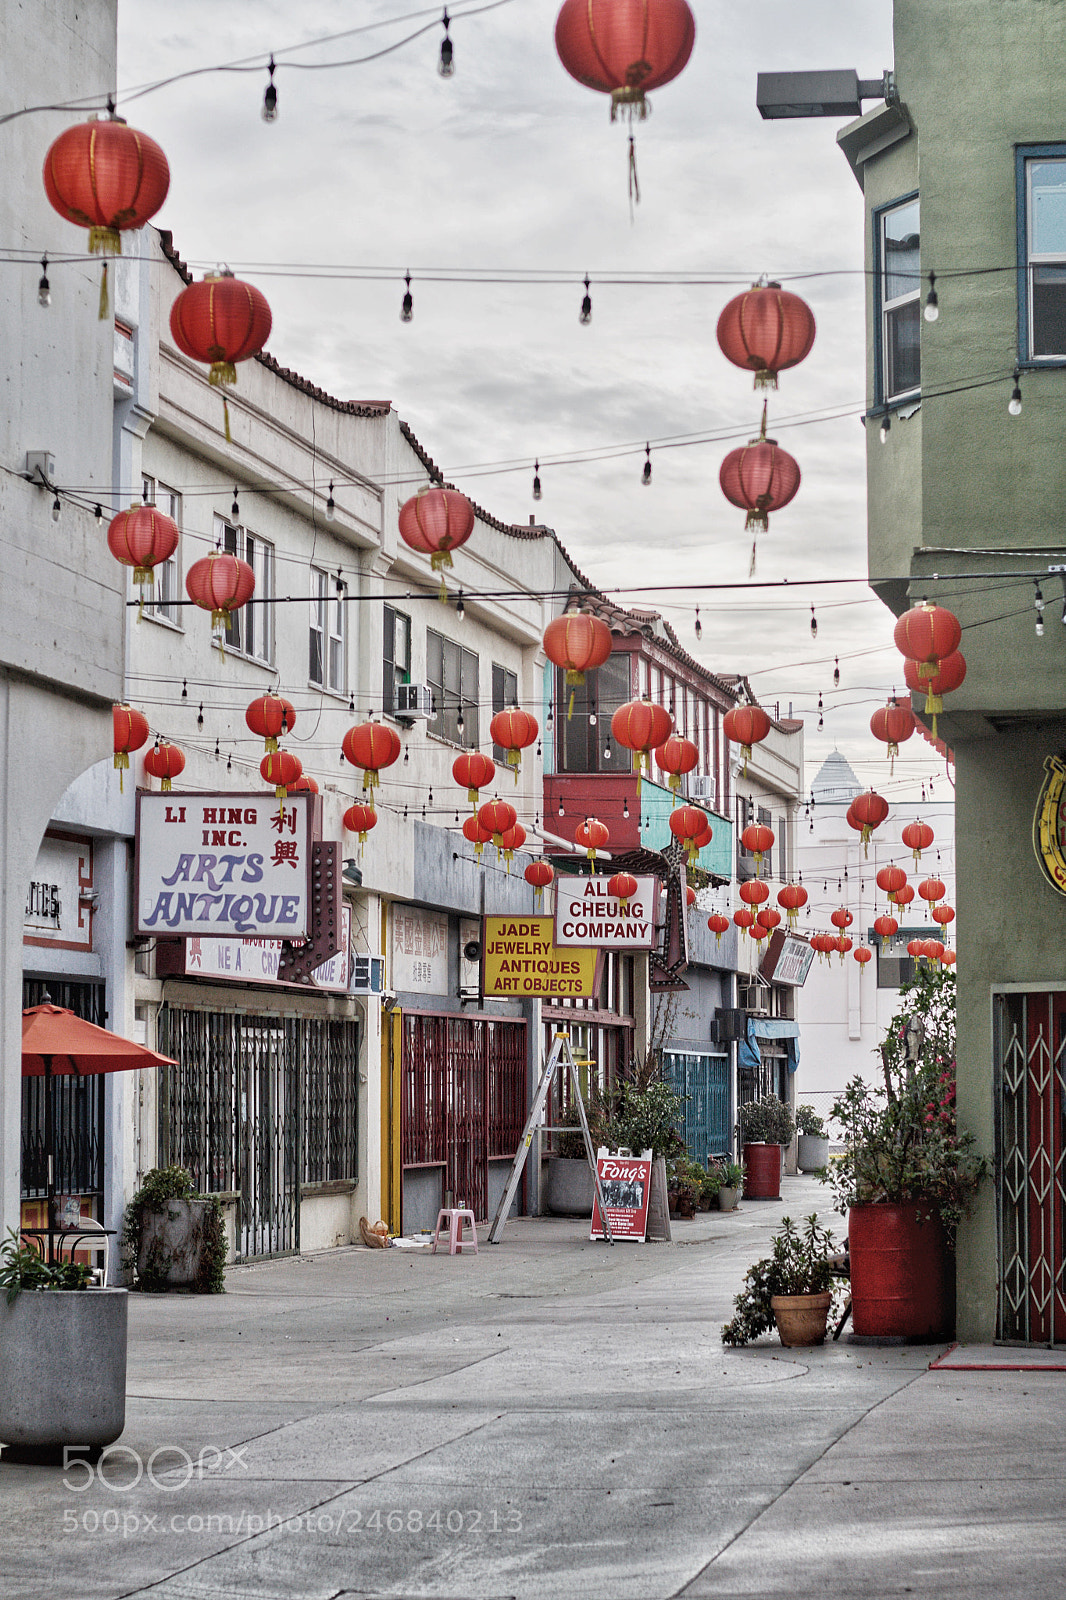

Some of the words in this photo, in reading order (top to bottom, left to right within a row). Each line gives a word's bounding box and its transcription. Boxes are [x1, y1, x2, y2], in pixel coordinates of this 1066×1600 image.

[165, 807, 186, 823] LI
[202, 808, 257, 824] HING
[202, 830, 247, 847] INC.
[270, 807, 299, 869] 利興
[161, 853, 264, 892] ARTS
[143, 892, 300, 932] ANTIQUE
[569, 901, 643, 918] CHEUNG
[498, 924, 540, 936] JADE
[562, 922, 648, 938] COMPANY
[487, 942, 551, 955] JEWELRY
[499, 960, 580, 974] ANTIQUES
[494, 978, 520, 990] ART
[523, 978, 583, 992] OBJECTS
[600, 1160, 647, 1185] Fong's
